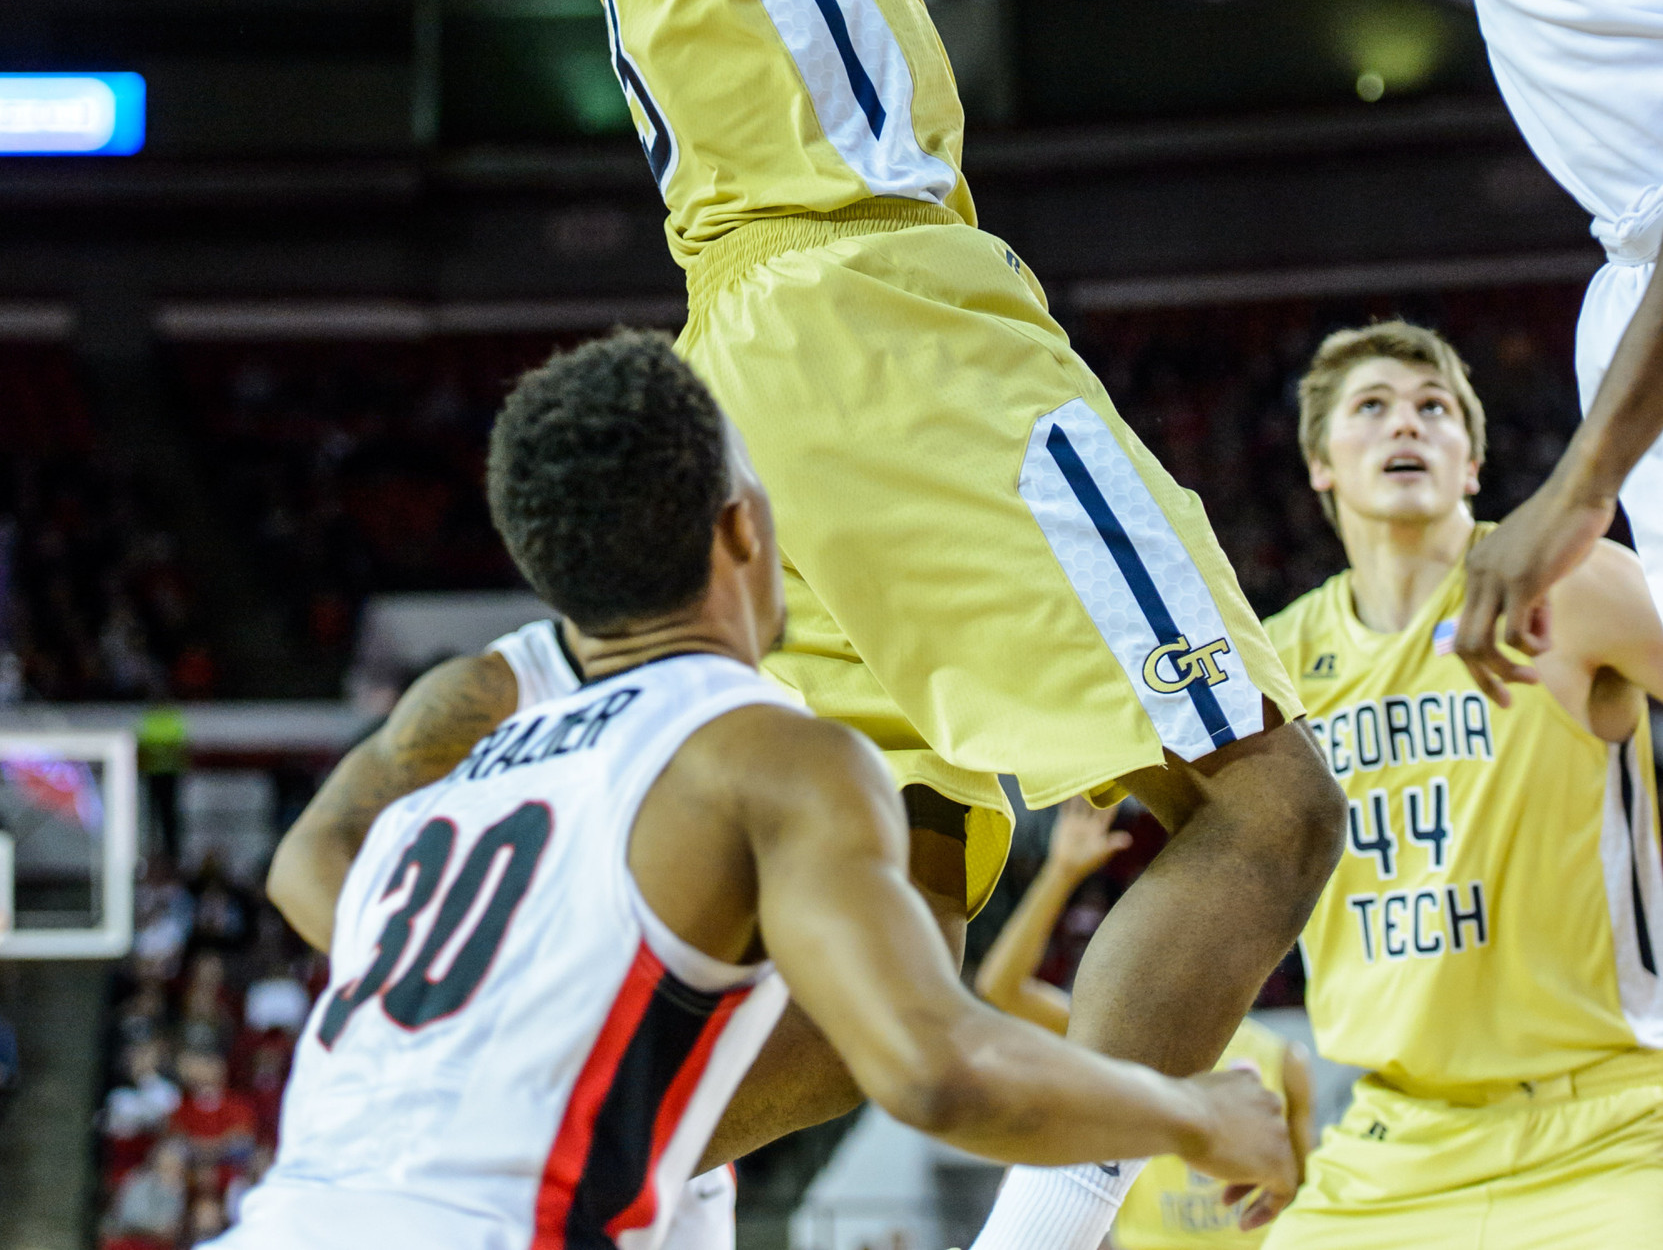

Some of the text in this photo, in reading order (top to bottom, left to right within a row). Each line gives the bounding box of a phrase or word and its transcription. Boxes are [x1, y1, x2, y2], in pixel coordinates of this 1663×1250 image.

[1142, 634, 1231, 694] GT
[1348, 777, 1451, 879] 44
[317, 800, 554, 1052] 30
[1348, 881, 1489, 963] TECH
